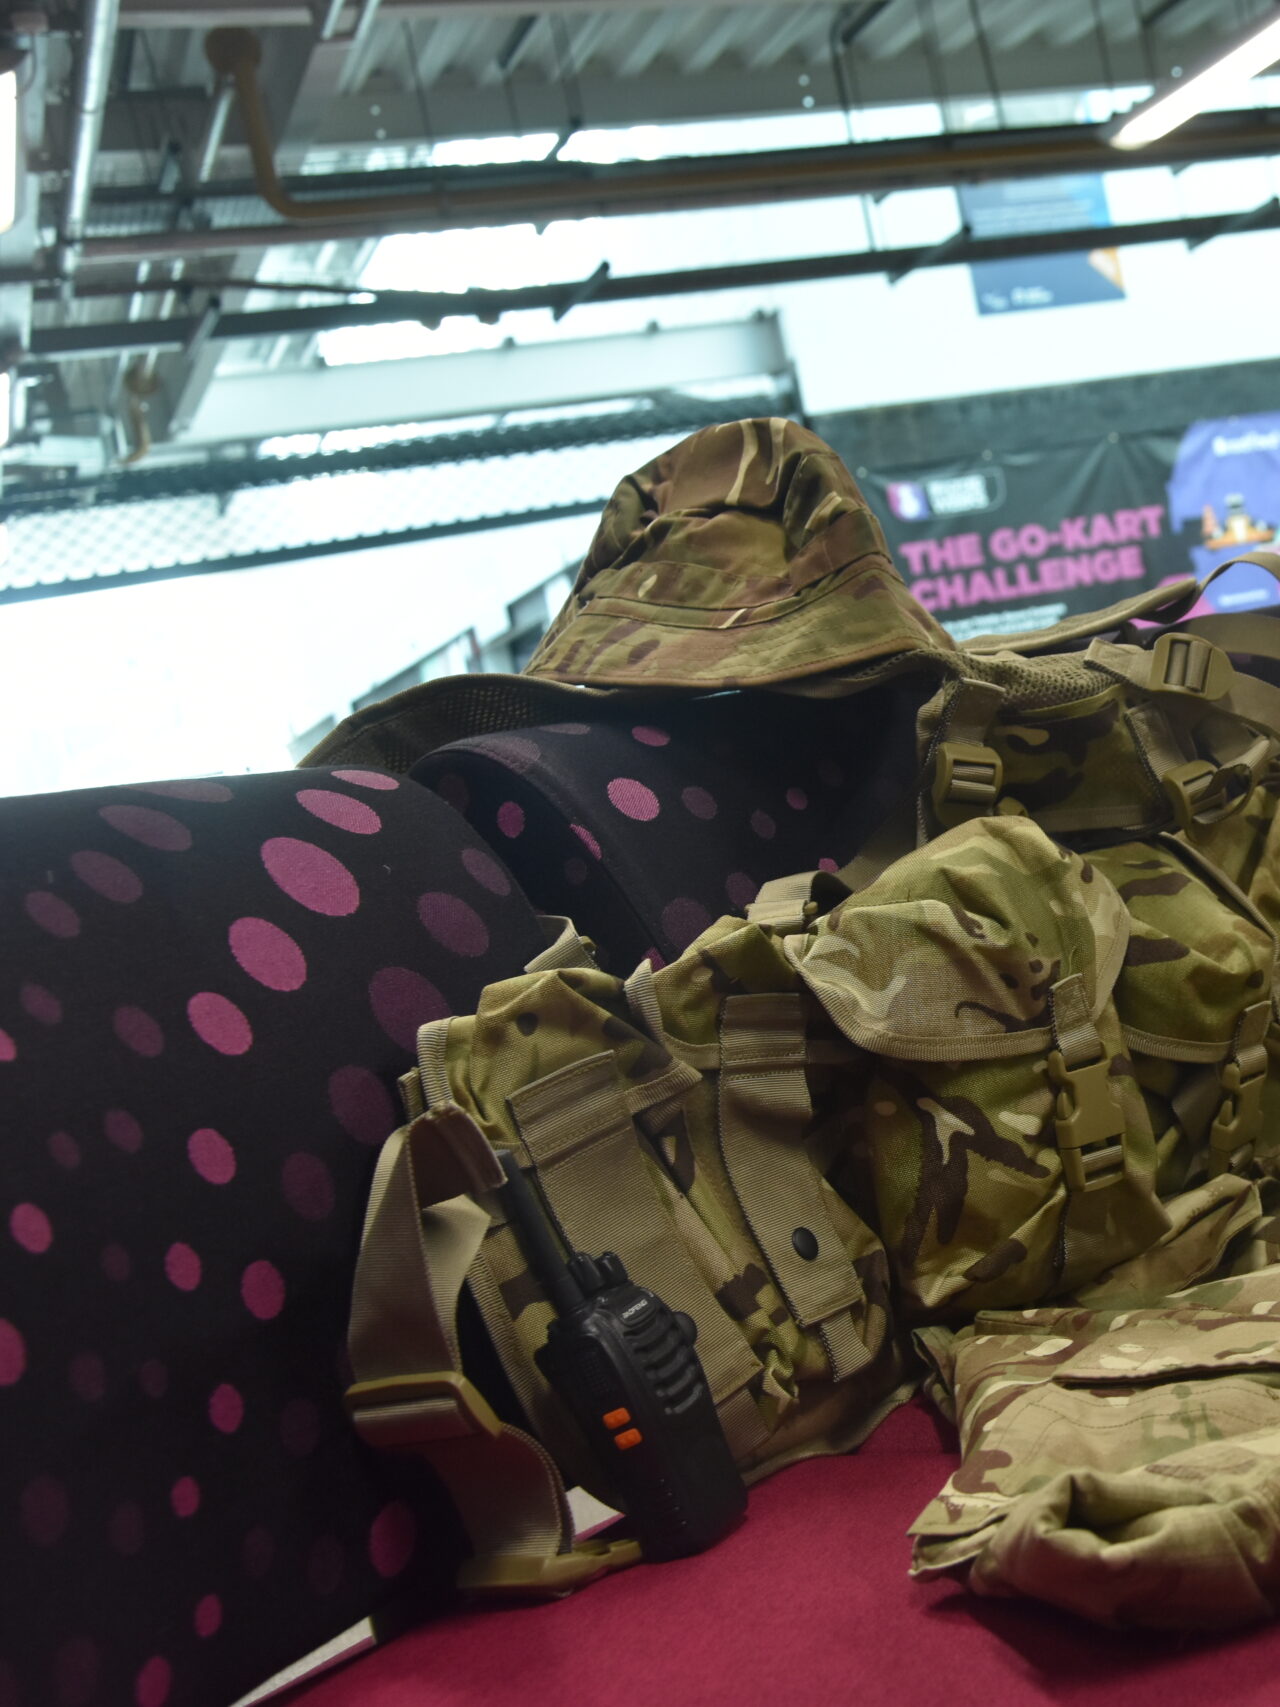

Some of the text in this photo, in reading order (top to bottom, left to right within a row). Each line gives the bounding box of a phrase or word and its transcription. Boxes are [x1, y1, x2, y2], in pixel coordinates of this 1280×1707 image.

[899, 505, 1164, 576] THE GO-KART
[910, 545, 1145, 613] CHALLENGE
